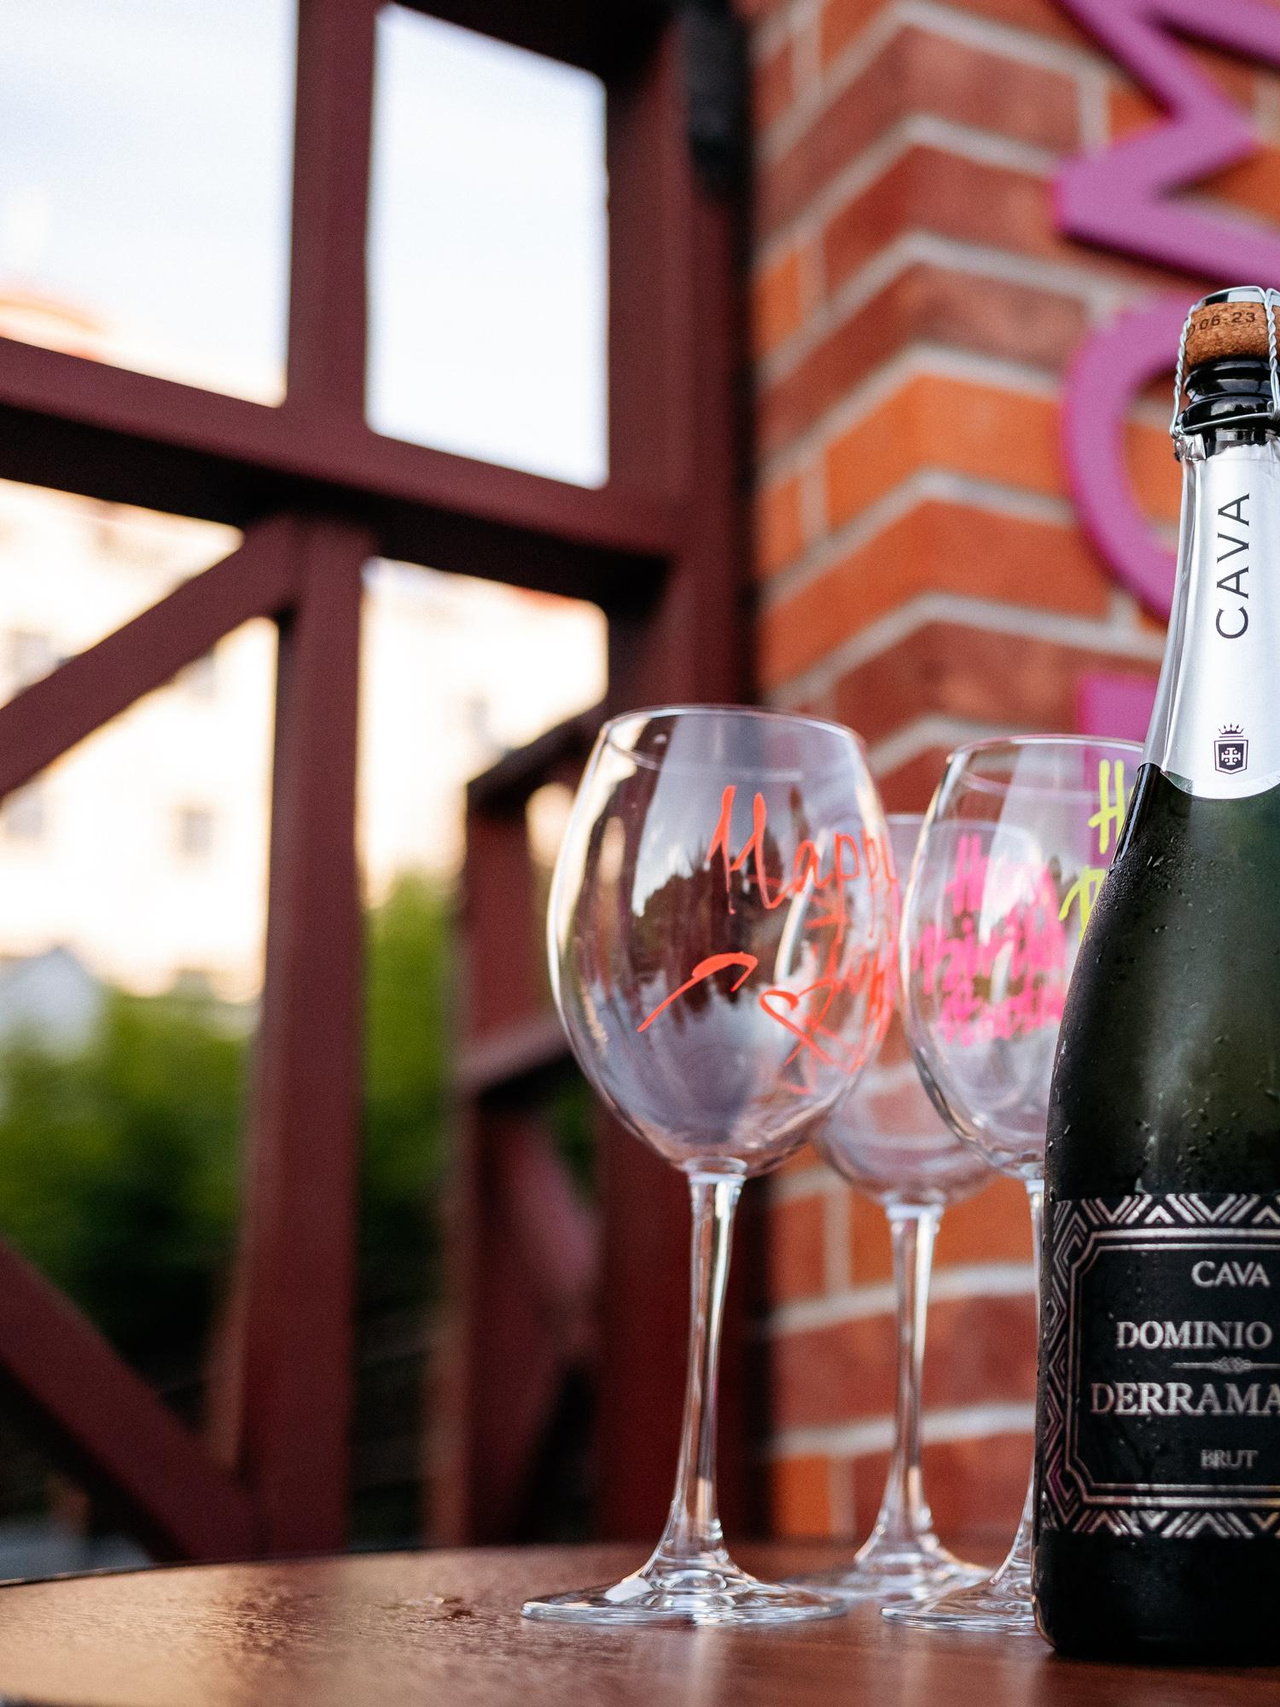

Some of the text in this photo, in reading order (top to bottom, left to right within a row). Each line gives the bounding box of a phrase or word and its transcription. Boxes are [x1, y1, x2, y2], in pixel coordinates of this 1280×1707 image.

[1215, 492, 1250, 640] CAVA
[1190, 1260, 1271, 1288] CAVA
[1115, 1320, 1274, 1350] DOMINIO
[1200, 1448, 1258, 1470] BRUT
